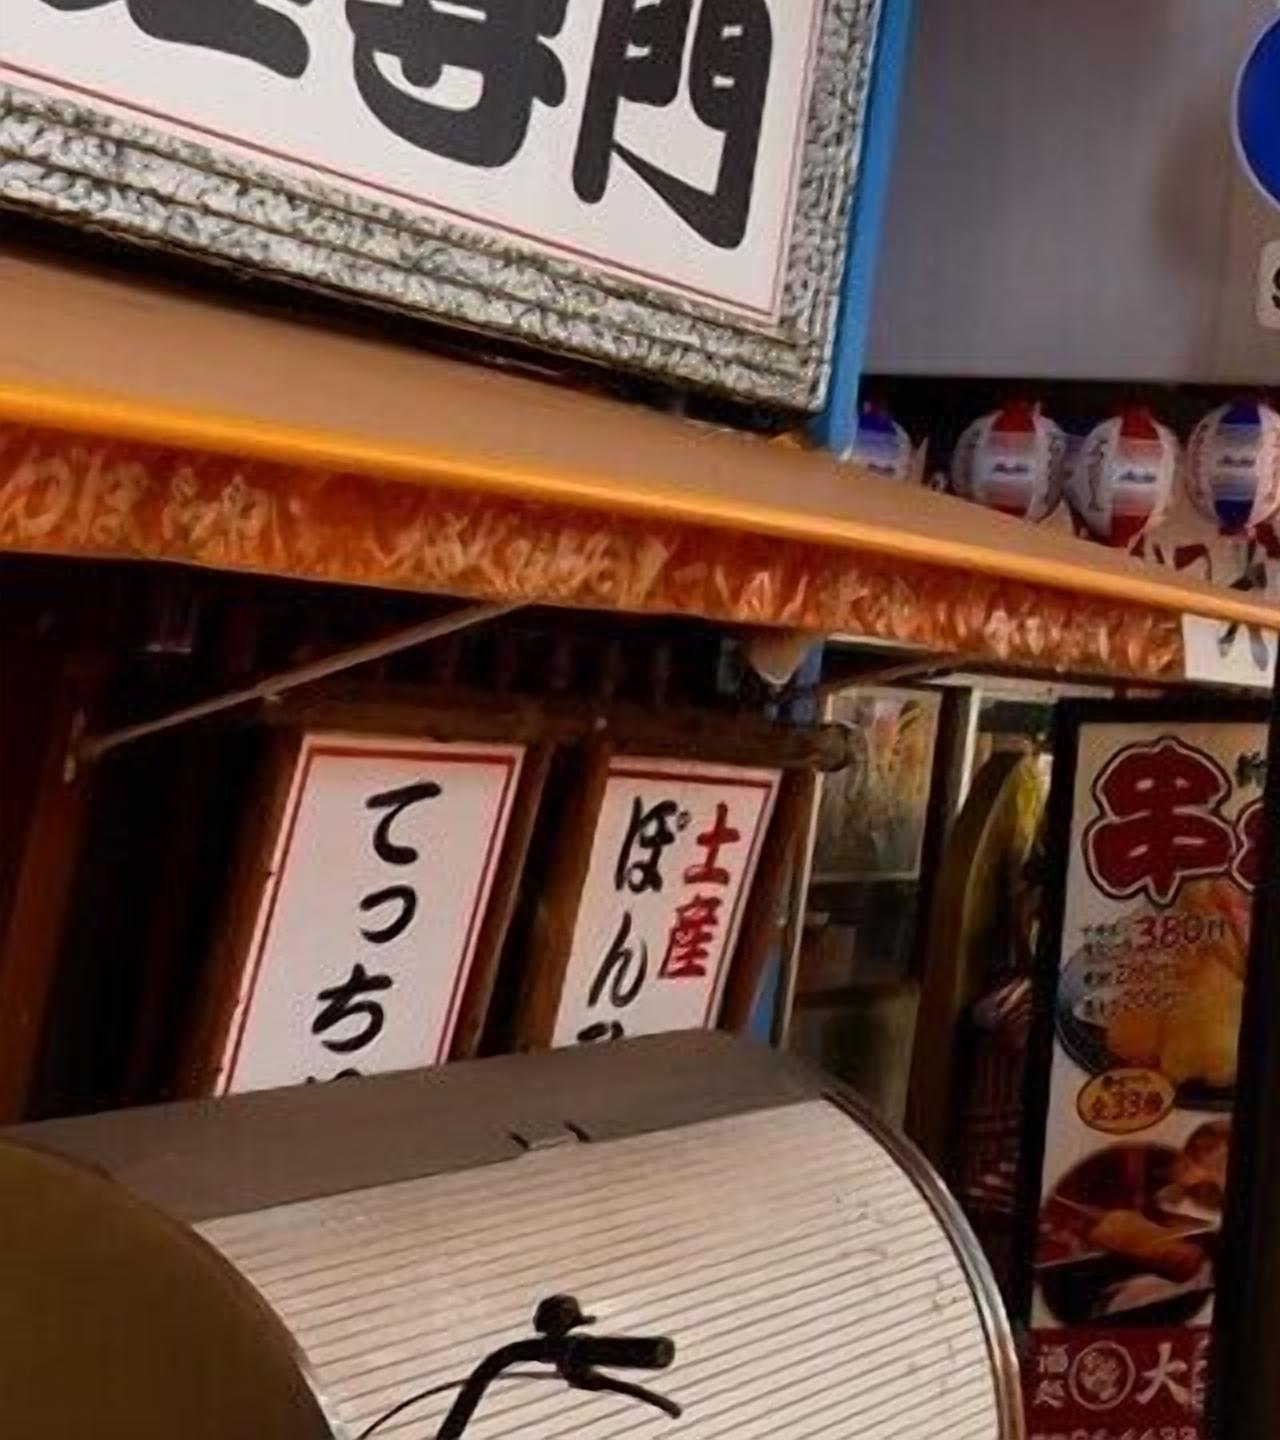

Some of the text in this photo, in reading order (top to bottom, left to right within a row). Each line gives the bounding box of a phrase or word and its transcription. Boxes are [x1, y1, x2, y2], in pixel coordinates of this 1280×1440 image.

[306, 780, 443, 1084] てっち
[577, 795, 693, 1045] ぽん
[656, 802, 741, 981] 土産
